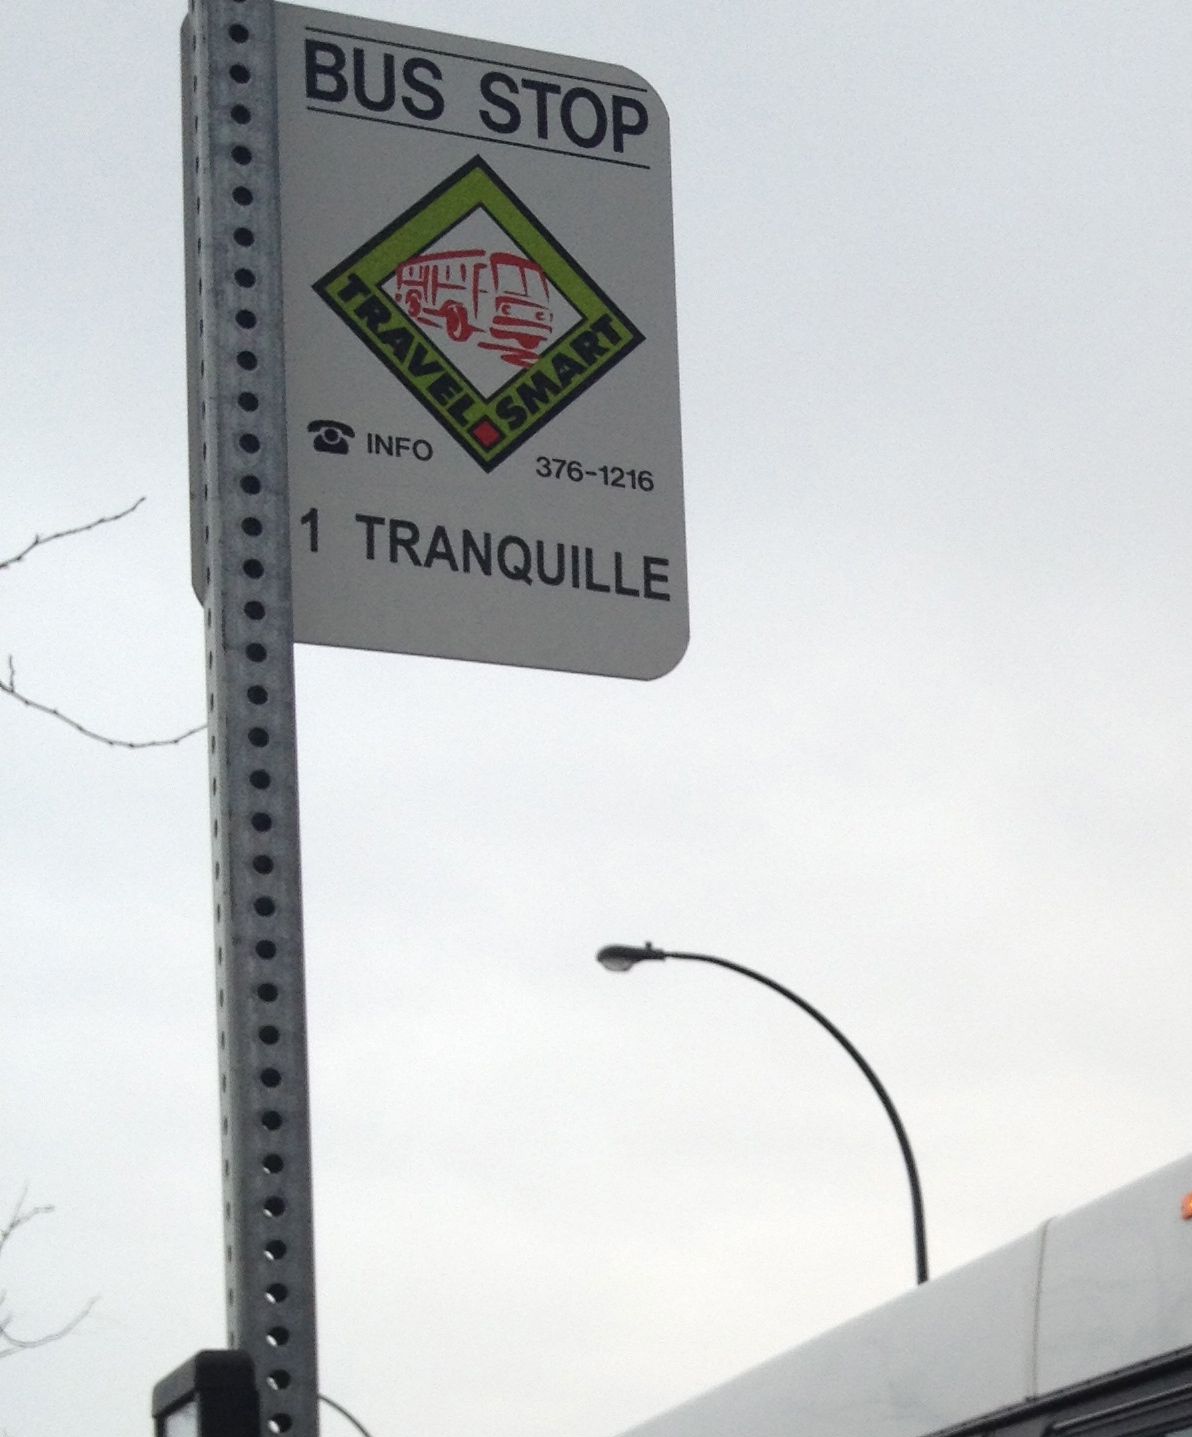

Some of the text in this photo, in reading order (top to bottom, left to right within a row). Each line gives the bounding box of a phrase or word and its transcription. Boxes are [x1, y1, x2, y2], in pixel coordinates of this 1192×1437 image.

[304, 39, 650, 154] BUS STOP
[337, 273, 622, 431] TRAVEL SMART
[366, 432, 434, 462] INFO
[535, 456, 655, 492] 376-1216
[300, 507, 671, 602] 1 TRANQUILLE
